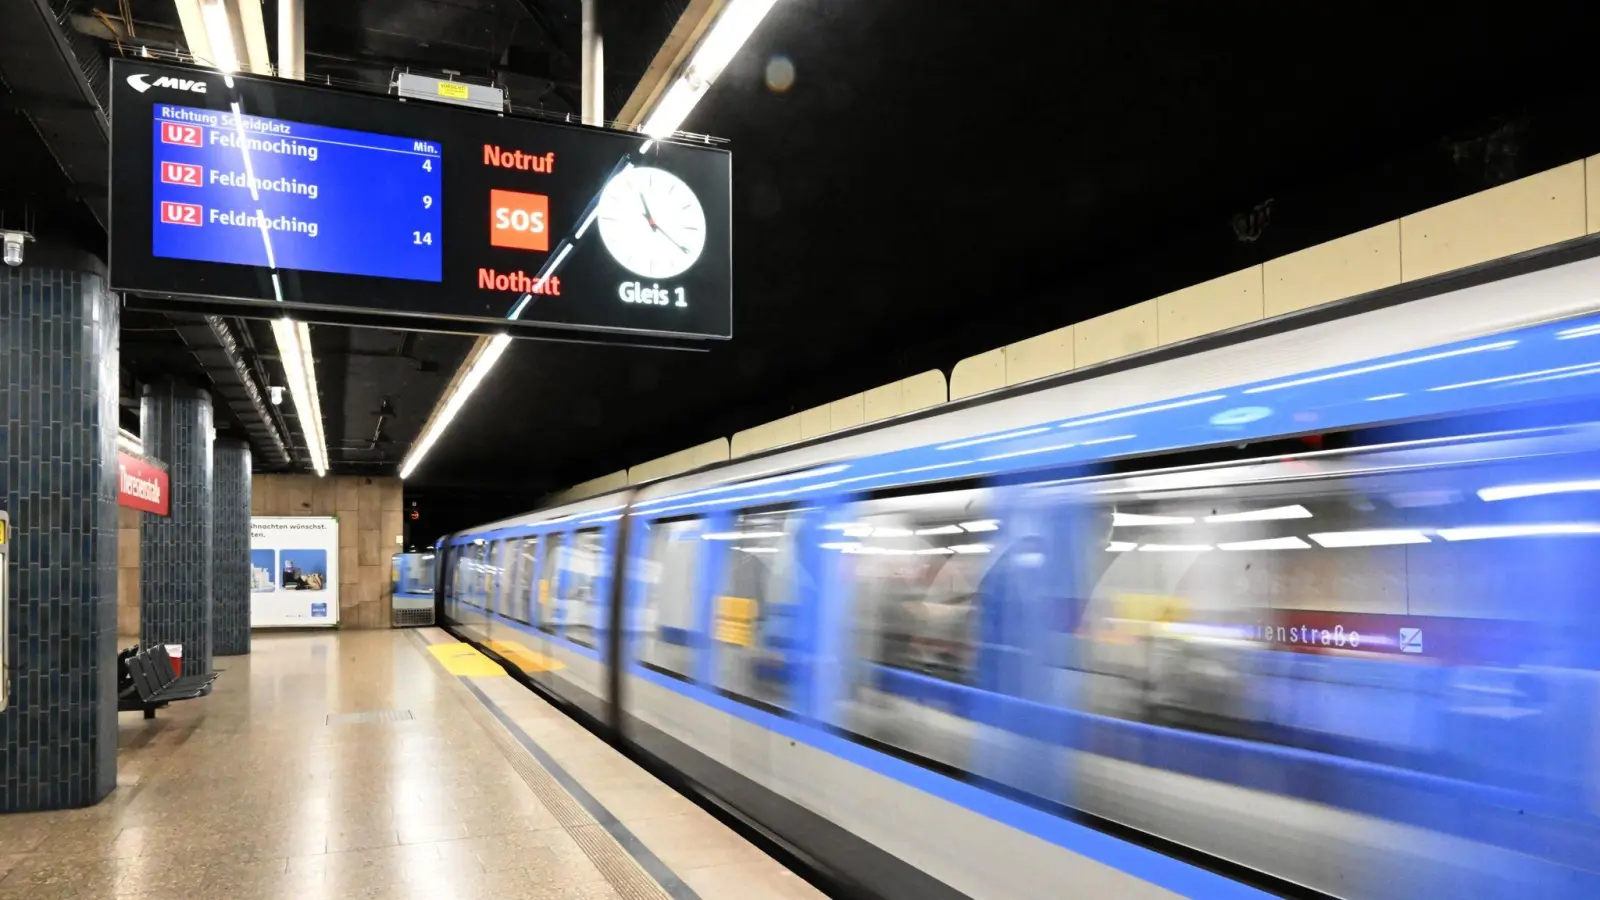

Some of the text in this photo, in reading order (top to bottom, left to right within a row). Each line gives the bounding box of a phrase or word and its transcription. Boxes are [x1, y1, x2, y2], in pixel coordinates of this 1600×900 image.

[151, 75, 207, 93] MVG
[161, 106, 291, 134] Richtung Sceidplatz
[167, 125, 197, 143] U2
[422, 159, 433, 172] 4
[413, 141, 438, 154] Min.
[484, 143, 555, 173] Notruf
[167, 164, 433, 209] U2 Feldmoching 9
[167, 204, 433, 245] U2 Feldmoching 14
[495, 207, 545, 233] SOS
[478, 268, 561, 296] Nothalt
[618, 281, 688, 307] Gleis 1
[1250, 619, 1361, 647] ienstraße
